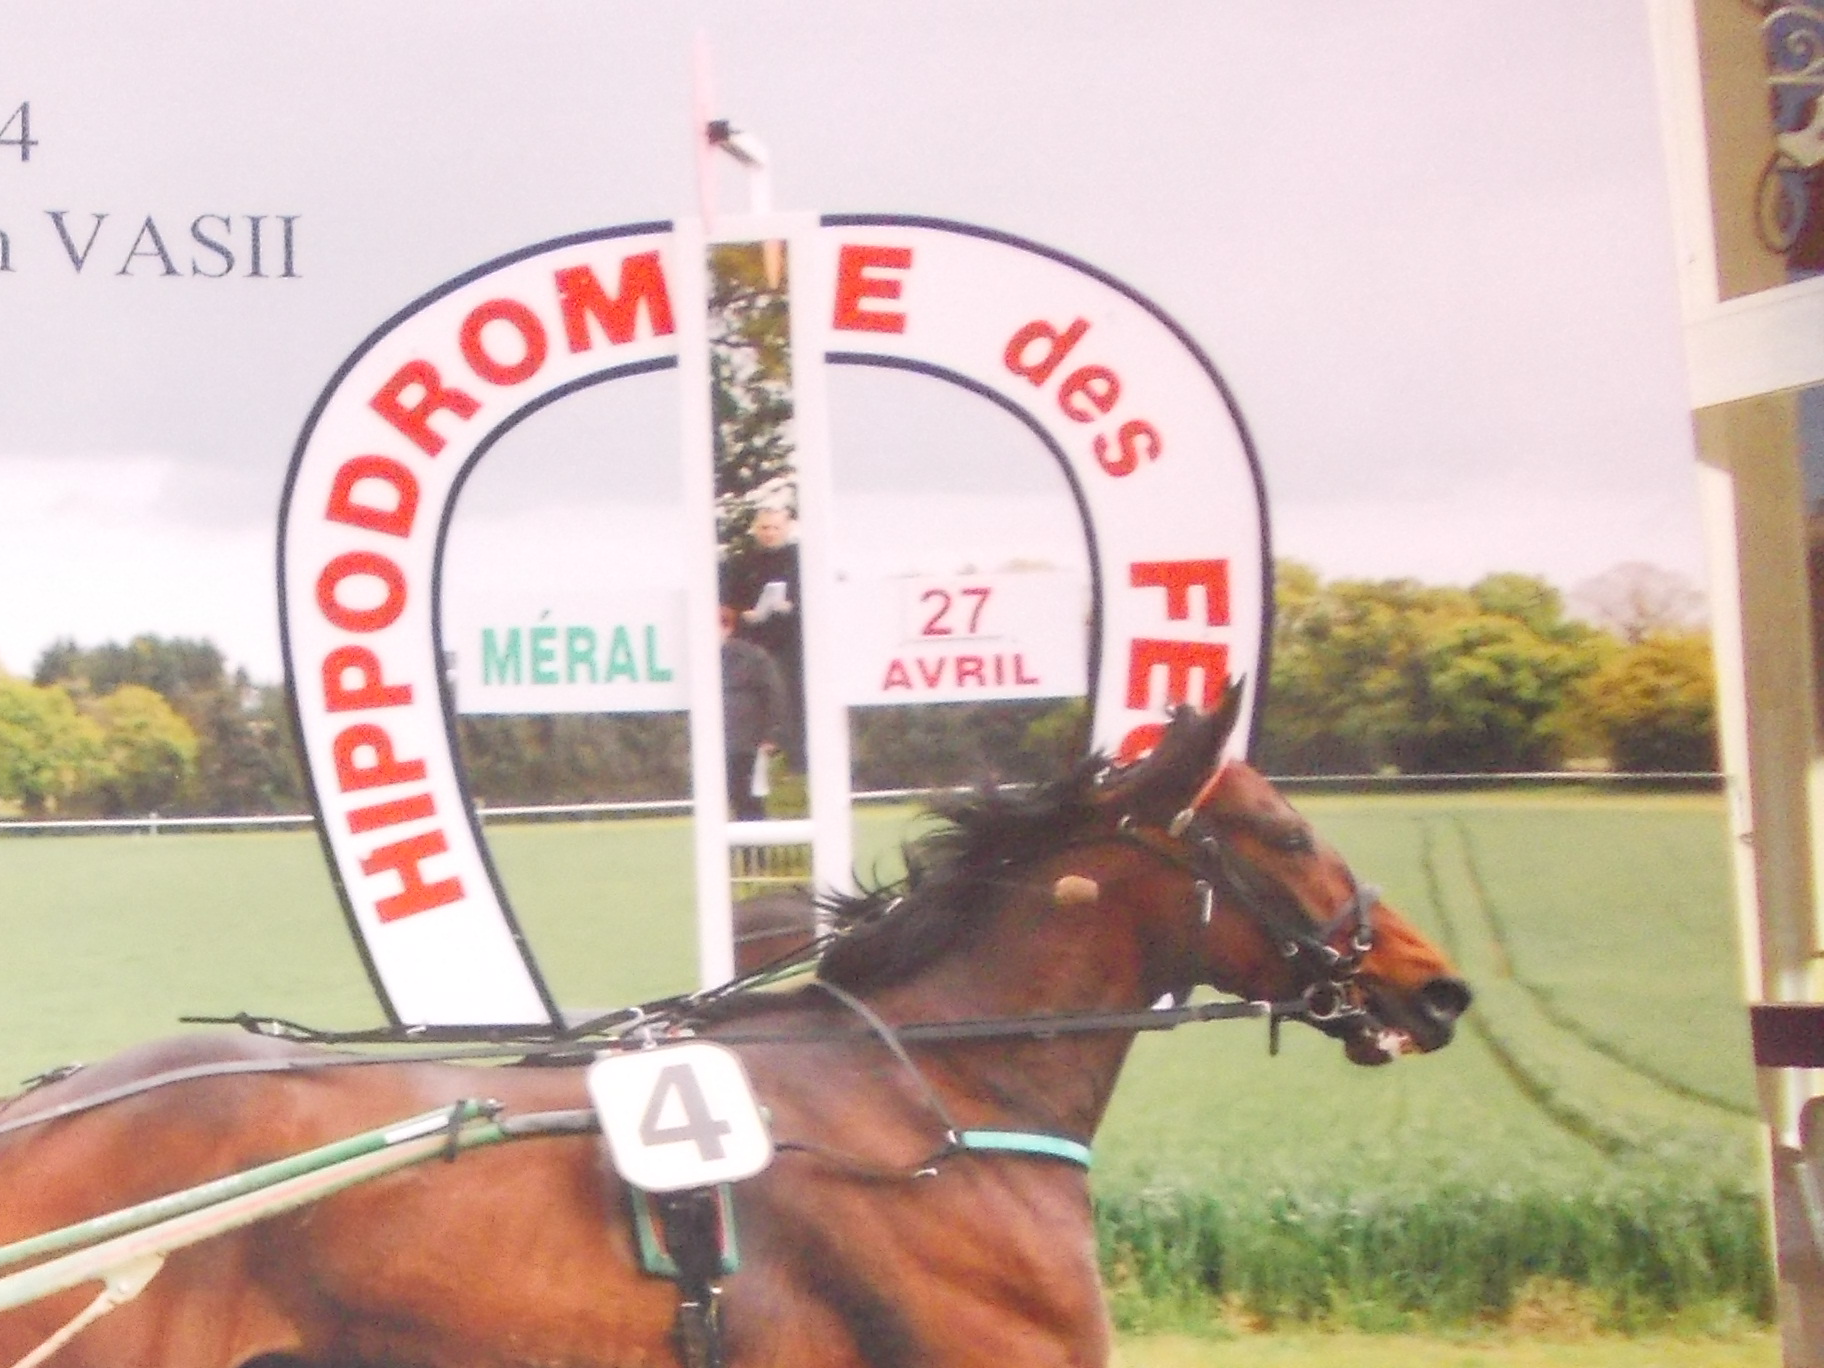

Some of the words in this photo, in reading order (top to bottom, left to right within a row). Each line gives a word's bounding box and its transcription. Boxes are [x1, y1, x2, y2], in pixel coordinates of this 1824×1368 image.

[1002, 317, 1163, 479] des
[482, 609, 673, 683] MÉRAL
[921, 585, 994, 638] 27
[882, 652, 1041, 691] AVRIL
[639, 1063, 732, 1162] 4
